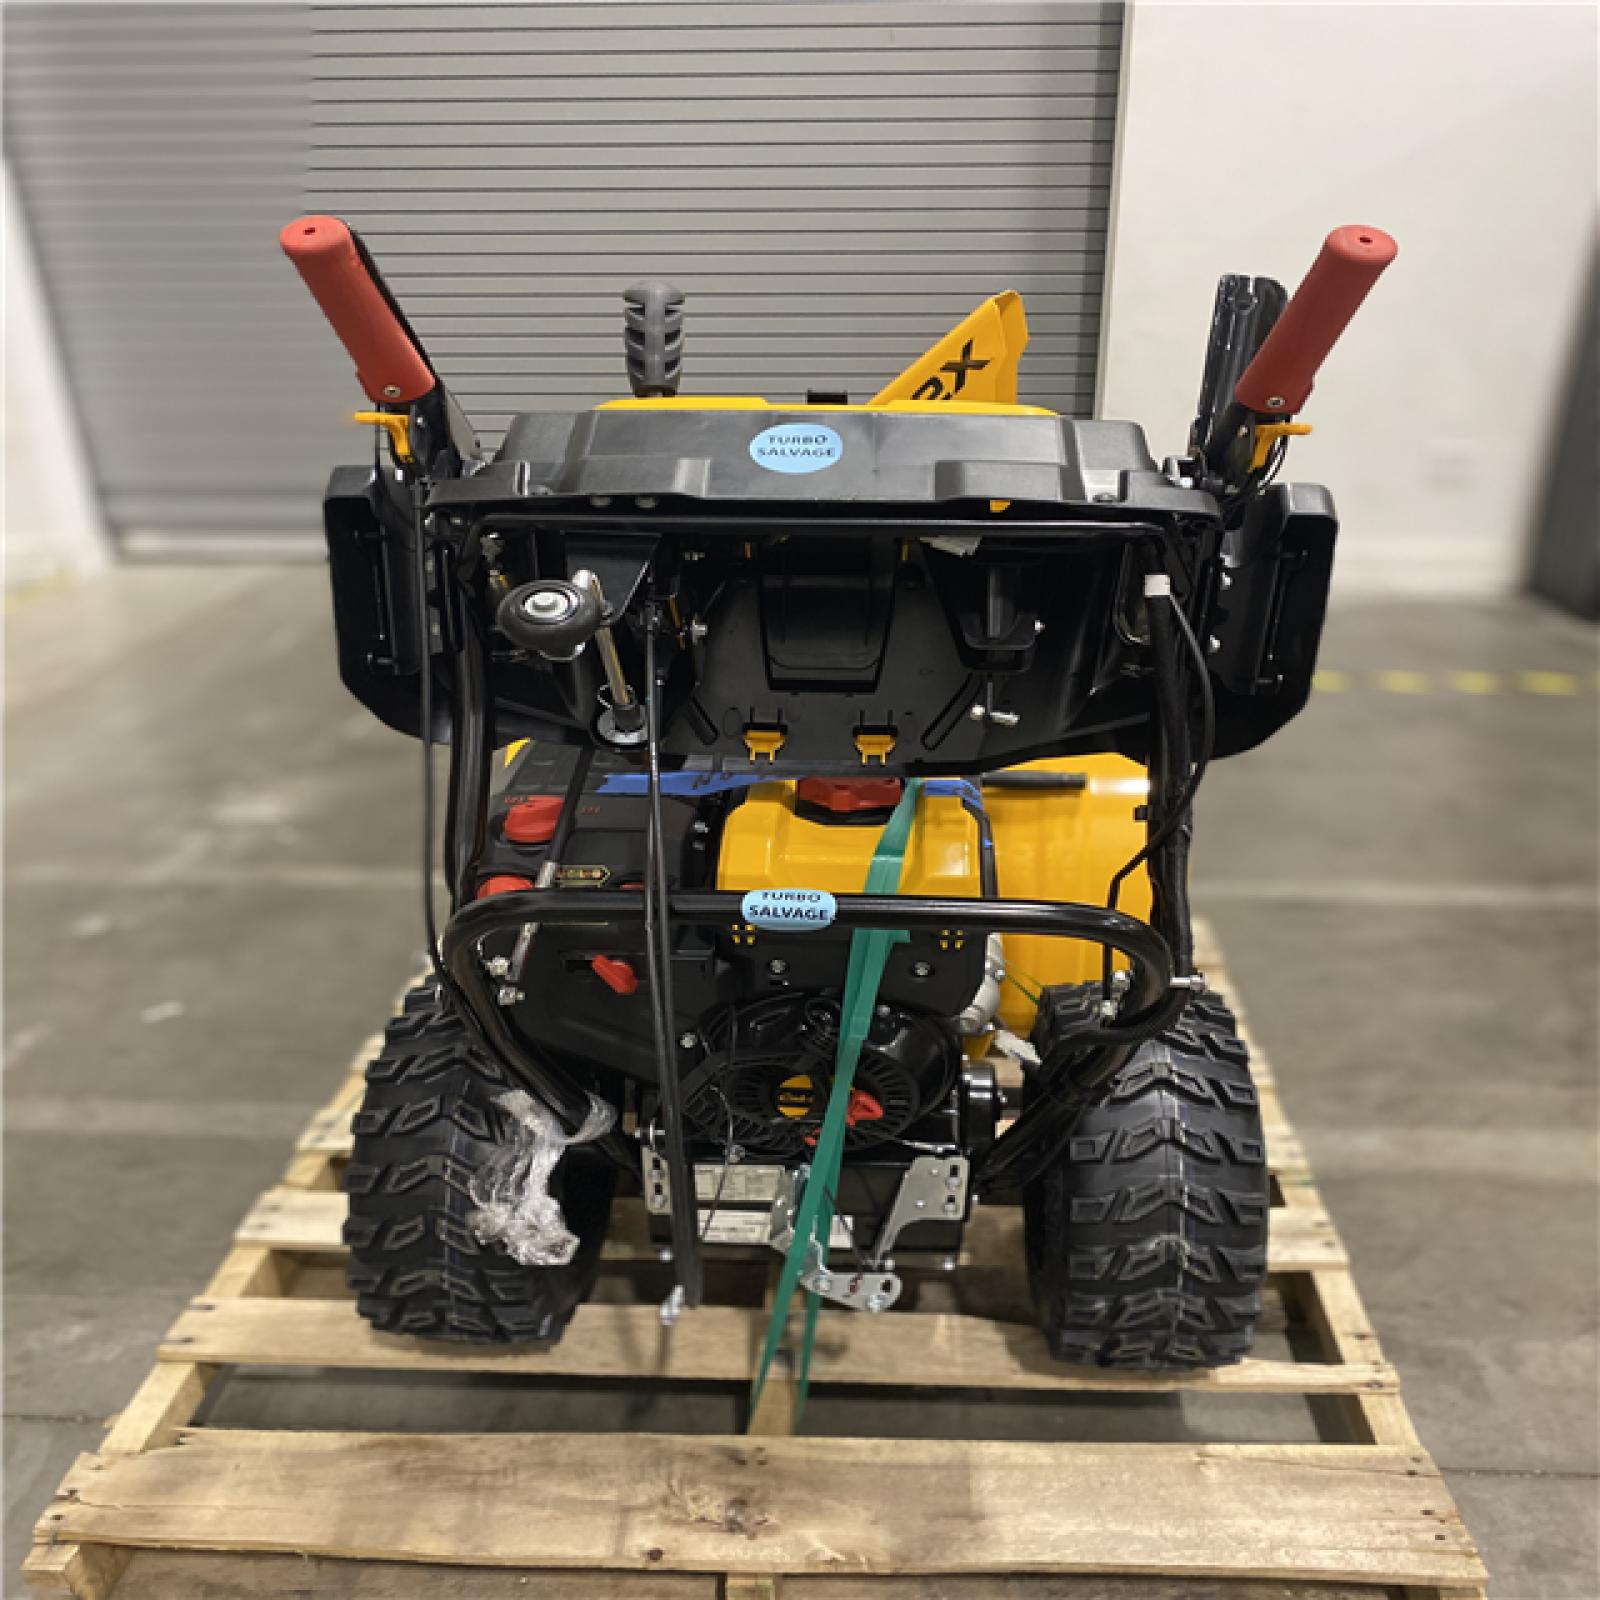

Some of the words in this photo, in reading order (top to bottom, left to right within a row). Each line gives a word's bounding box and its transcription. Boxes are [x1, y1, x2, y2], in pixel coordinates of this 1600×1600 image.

[767, 434, 828, 445] TURBO
[757, 447, 835, 458] SALVAGE
[761, 891, 820, 902] TURBO
[749, 904, 829, 920] SALVAGE
